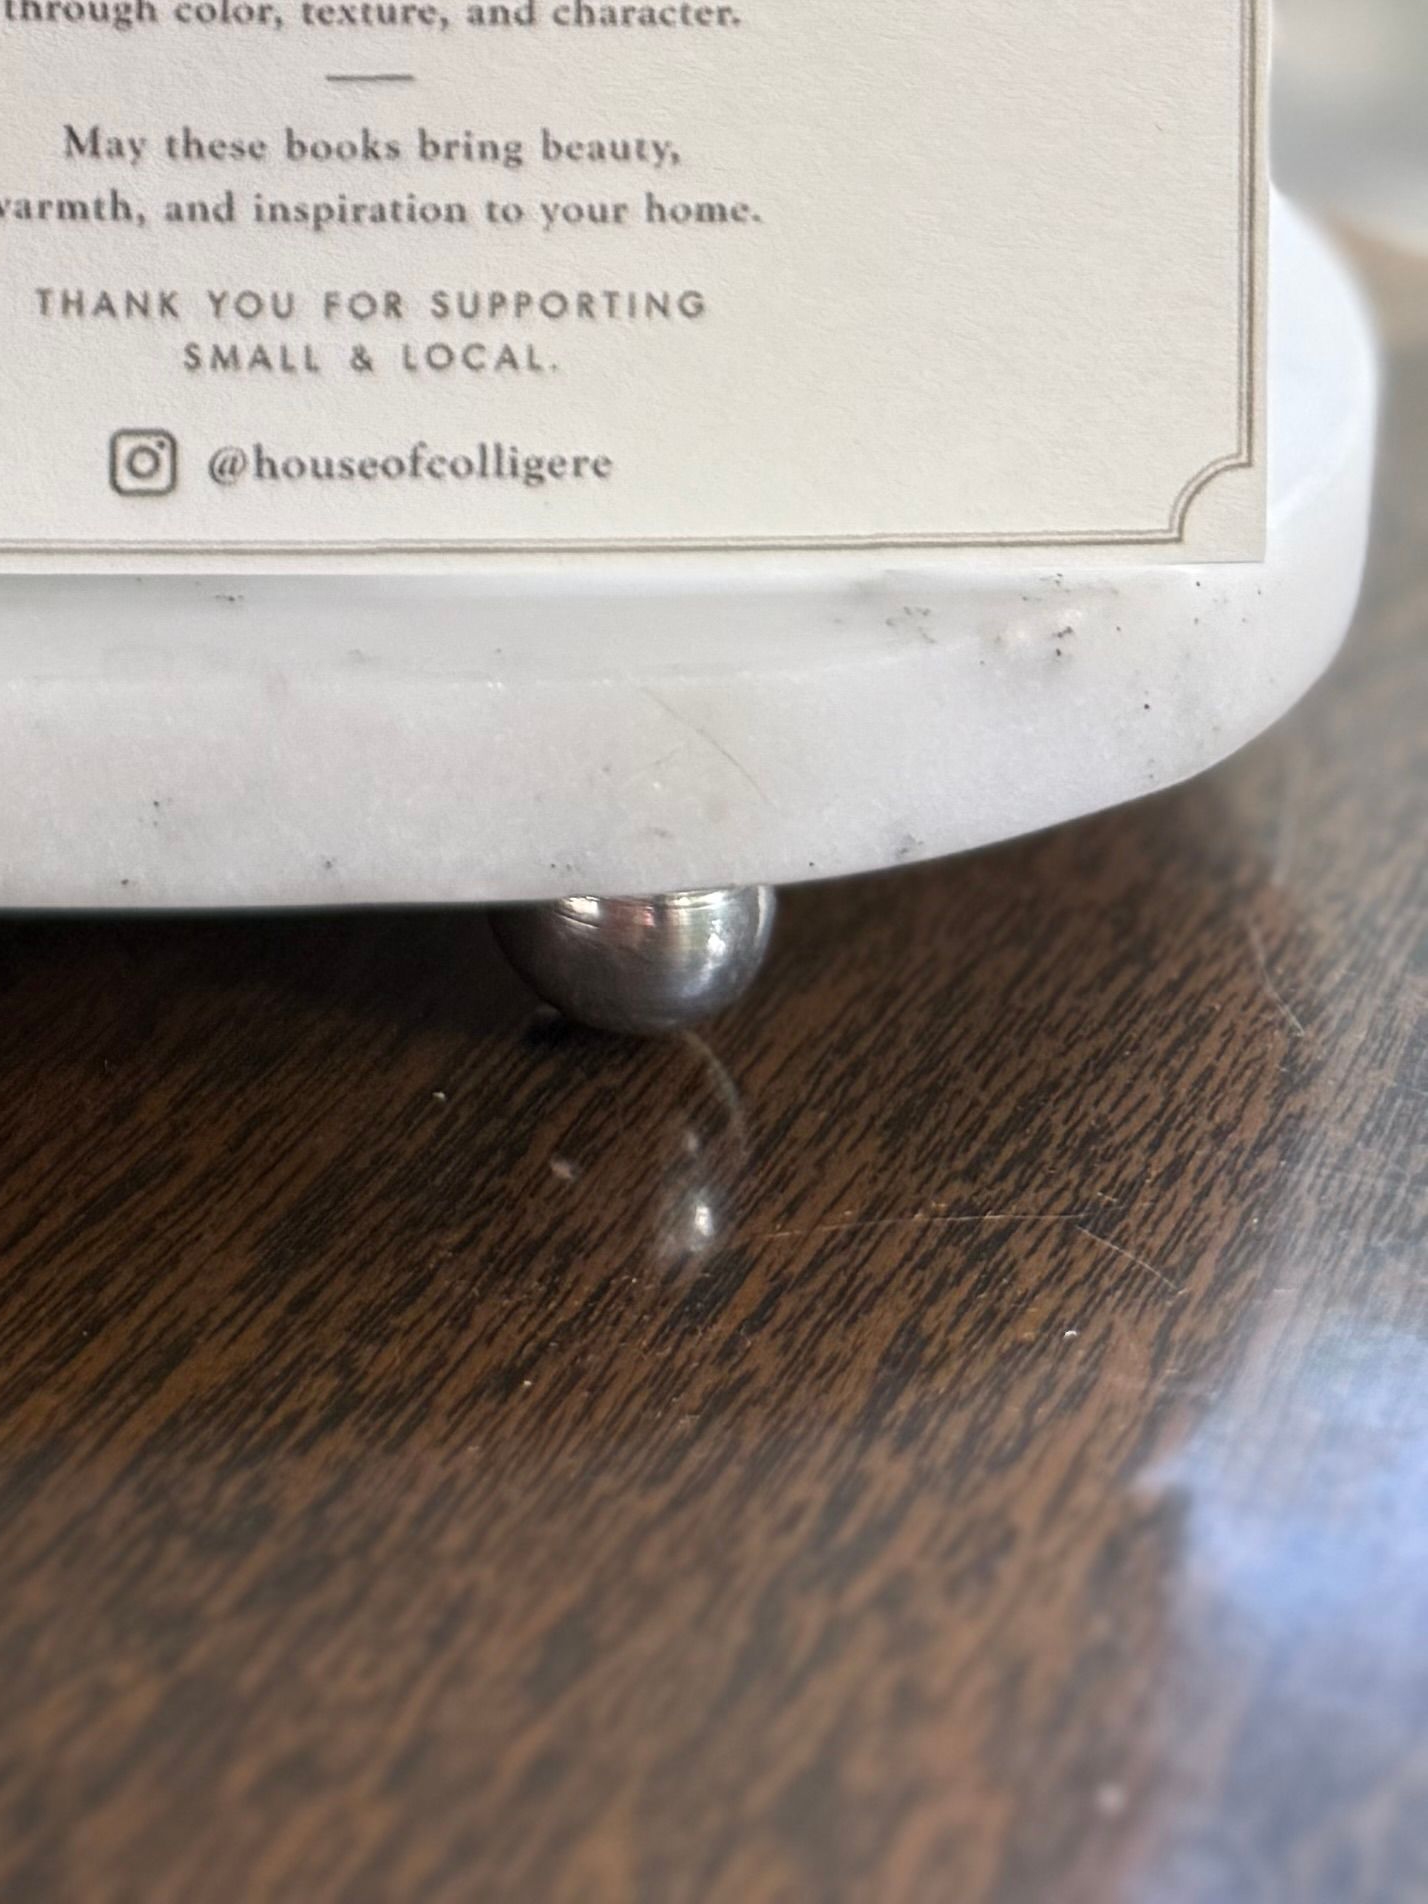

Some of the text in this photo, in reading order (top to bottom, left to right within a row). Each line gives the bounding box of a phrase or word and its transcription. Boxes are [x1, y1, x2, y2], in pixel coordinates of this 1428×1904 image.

[301, 1, 451, 32] texture,
[63, 123, 682, 171] May these books bring beauty,
[164, 189, 237, 225] and
[253, 192, 469, 234] inspiration
[485, 200, 526, 226] to
[539, 202, 629, 233] your
[645, 190, 762, 225] home.
[34, 287, 706, 323] THANK YOU FOR SUPPORTING
[183, 340, 558, 375] SMALL & LOCAL.
[207, 439, 613, 489] @houseofcolligere
